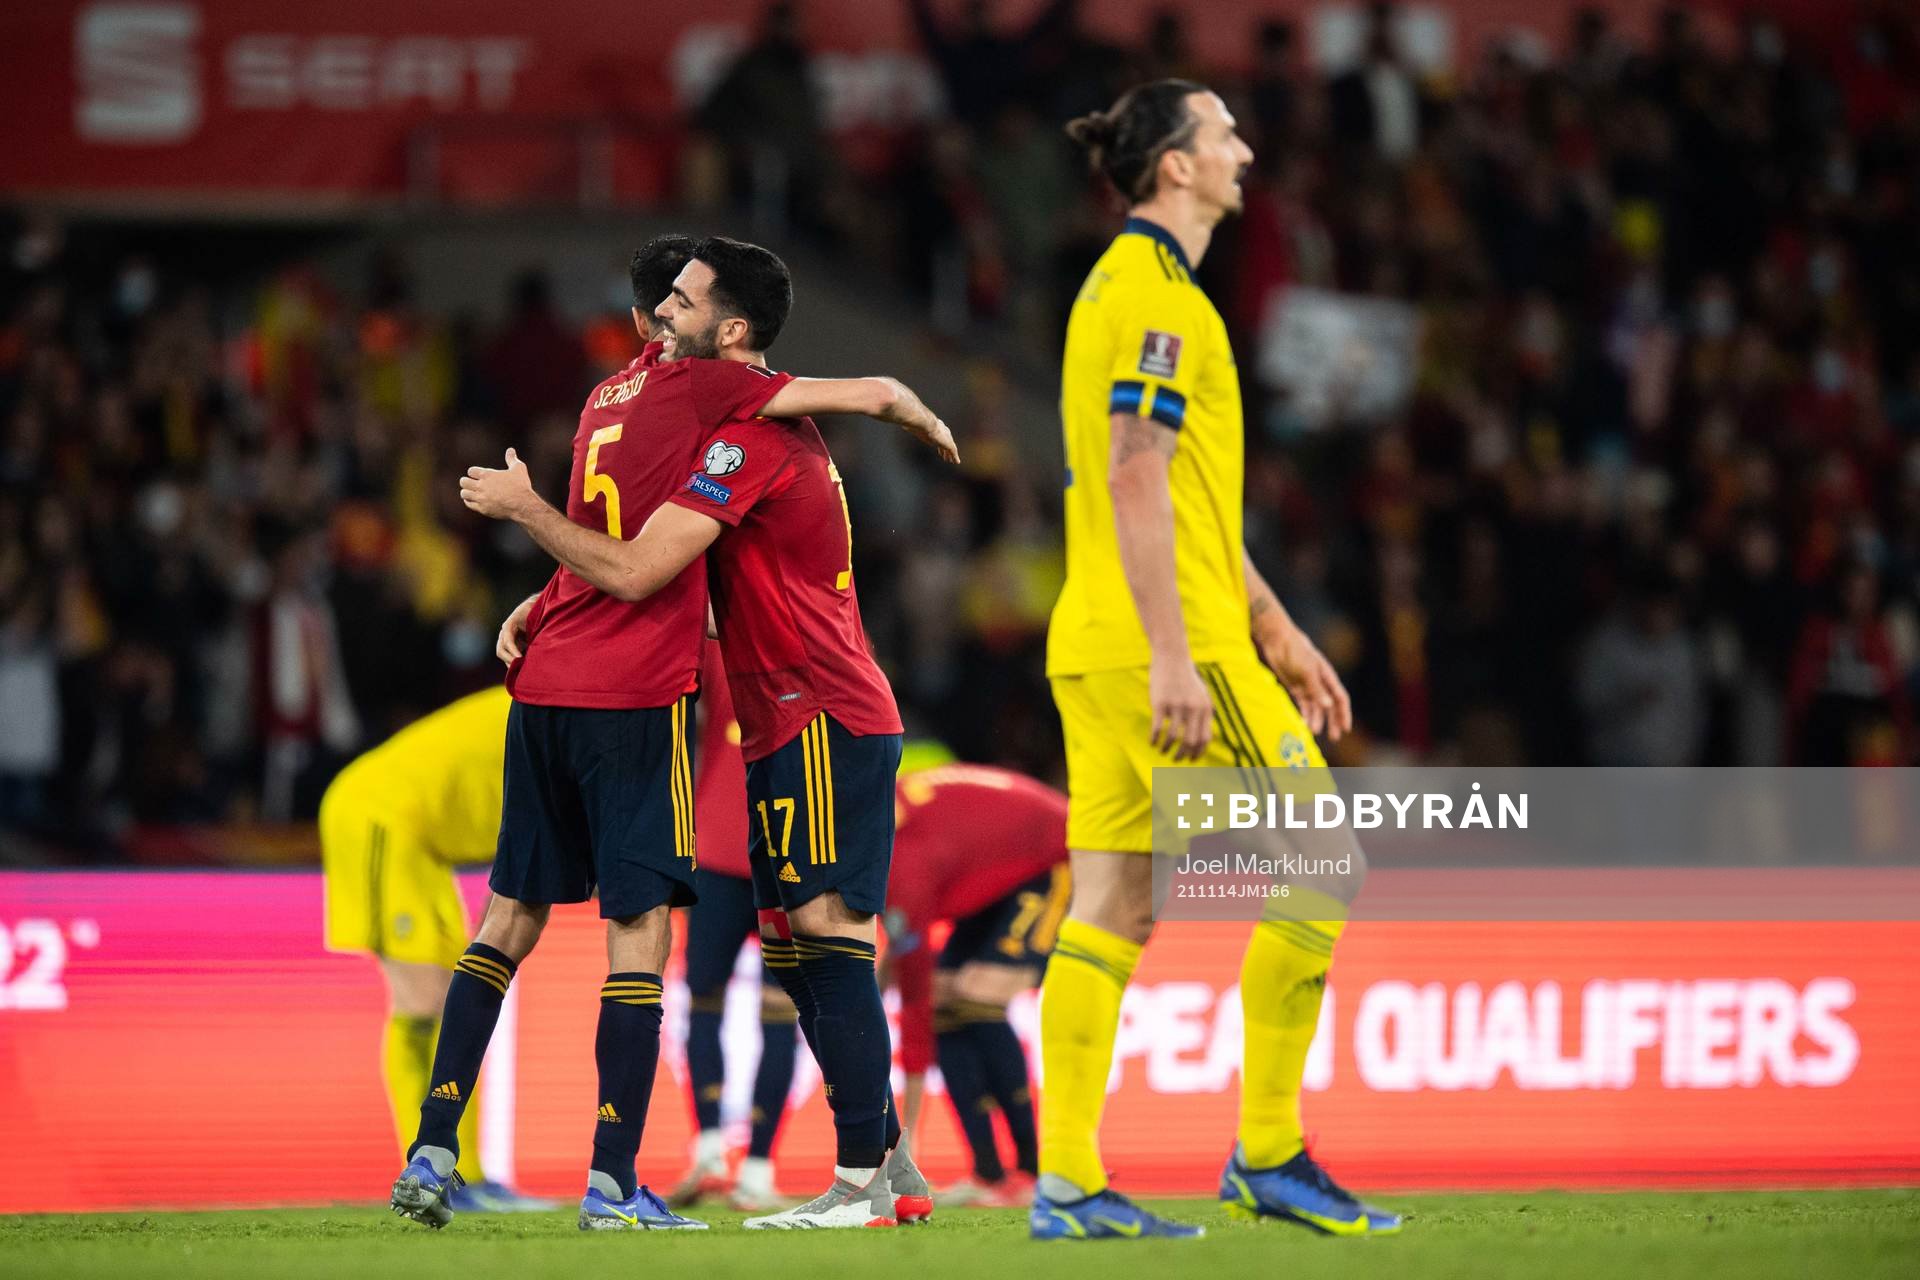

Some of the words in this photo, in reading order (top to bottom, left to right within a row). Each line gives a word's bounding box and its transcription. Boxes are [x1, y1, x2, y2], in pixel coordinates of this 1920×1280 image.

[226, 33, 530, 111] SEAT
[583, 423, 624, 541] 5
[694, 479, 730, 501] RESPECT
[756, 798, 795, 857] 17
[778, 873, 801, 883] adidas
[1353, 979, 1860, 1092] QUALIFIERS
[431, 1090, 462, 1102] adidas
[597, 1113, 622, 1123] didas
